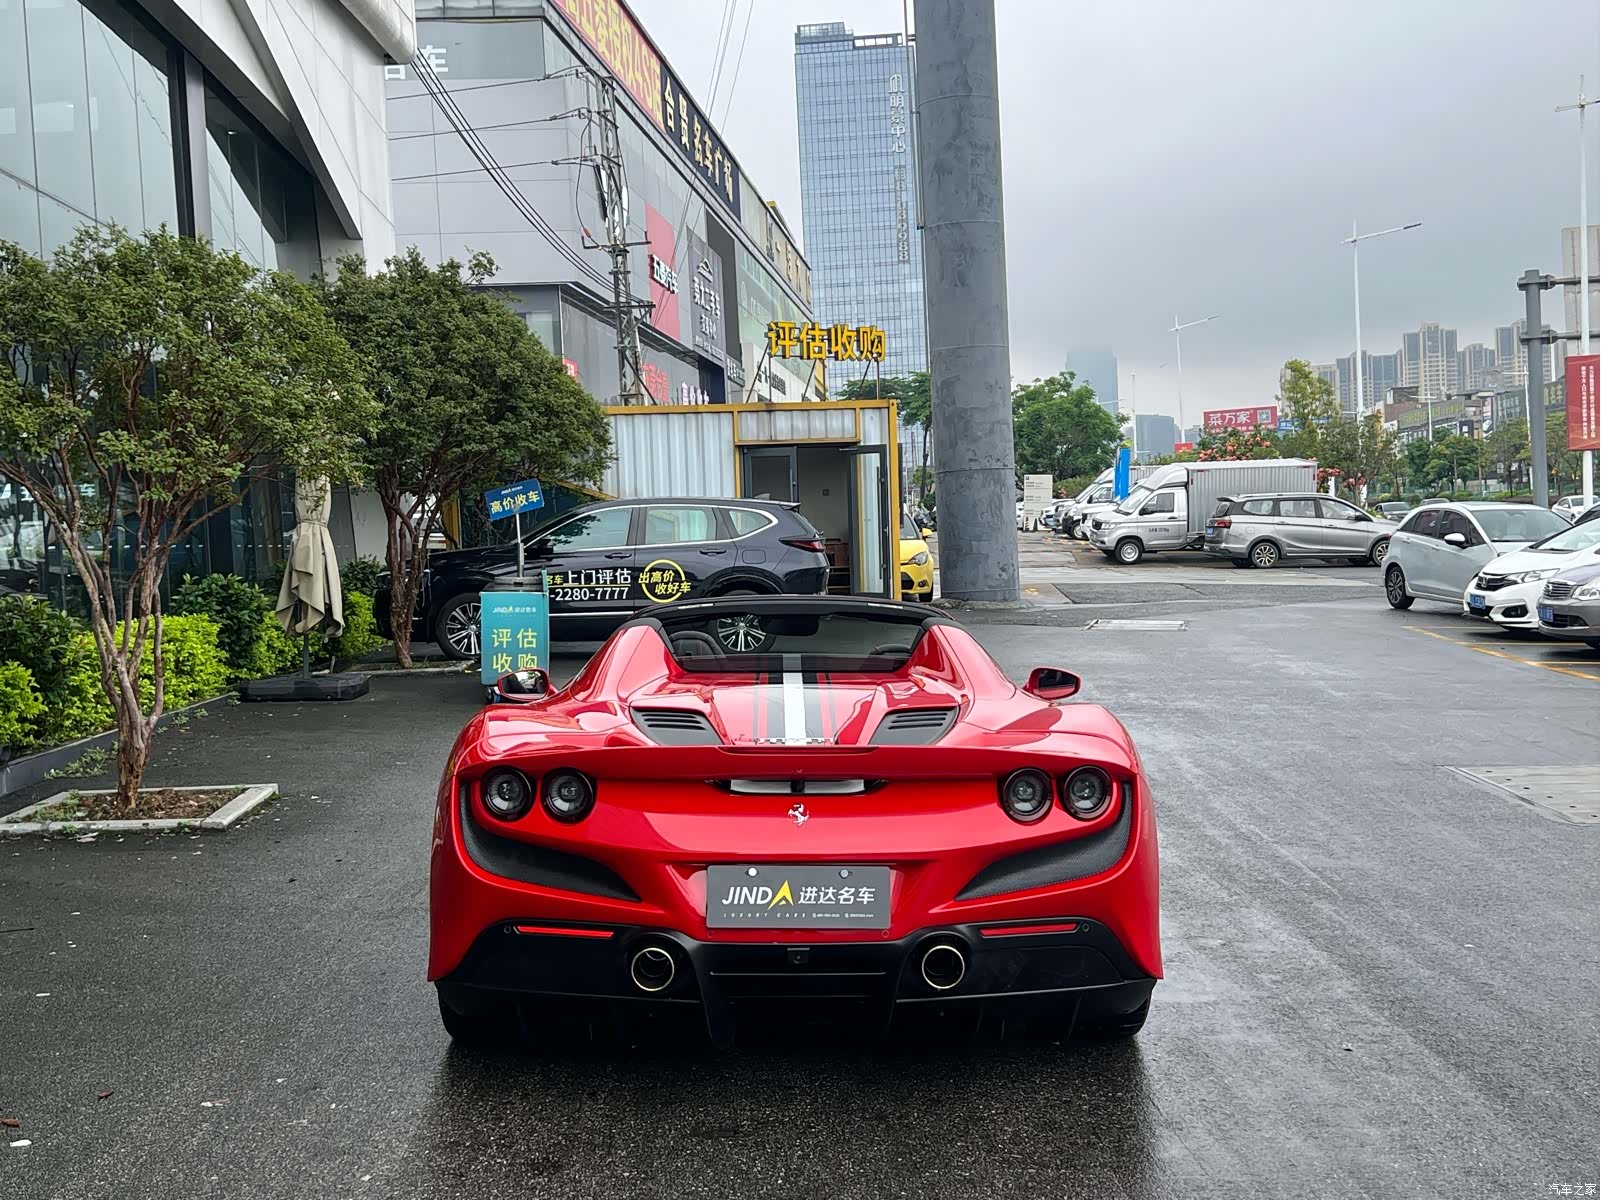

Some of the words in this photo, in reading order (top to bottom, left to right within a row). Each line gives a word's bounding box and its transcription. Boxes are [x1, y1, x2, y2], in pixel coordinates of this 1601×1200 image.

[767, 320, 886, 362] 评估收购
[1208, 411, 1251, 426] 菜万家
[490, 491, 540, 514] 高价收车
[563, 568, 632, 585] 上门评估
[638, 570, 675, 584] 出高价
[655, 581, 692, 595] 收好车
[492, 627, 538, 649] 评估
[492, 652, 538, 673] 收购
[721, 879, 795, 911] JINDA
[798, 886, 876, 905] 进达名车
